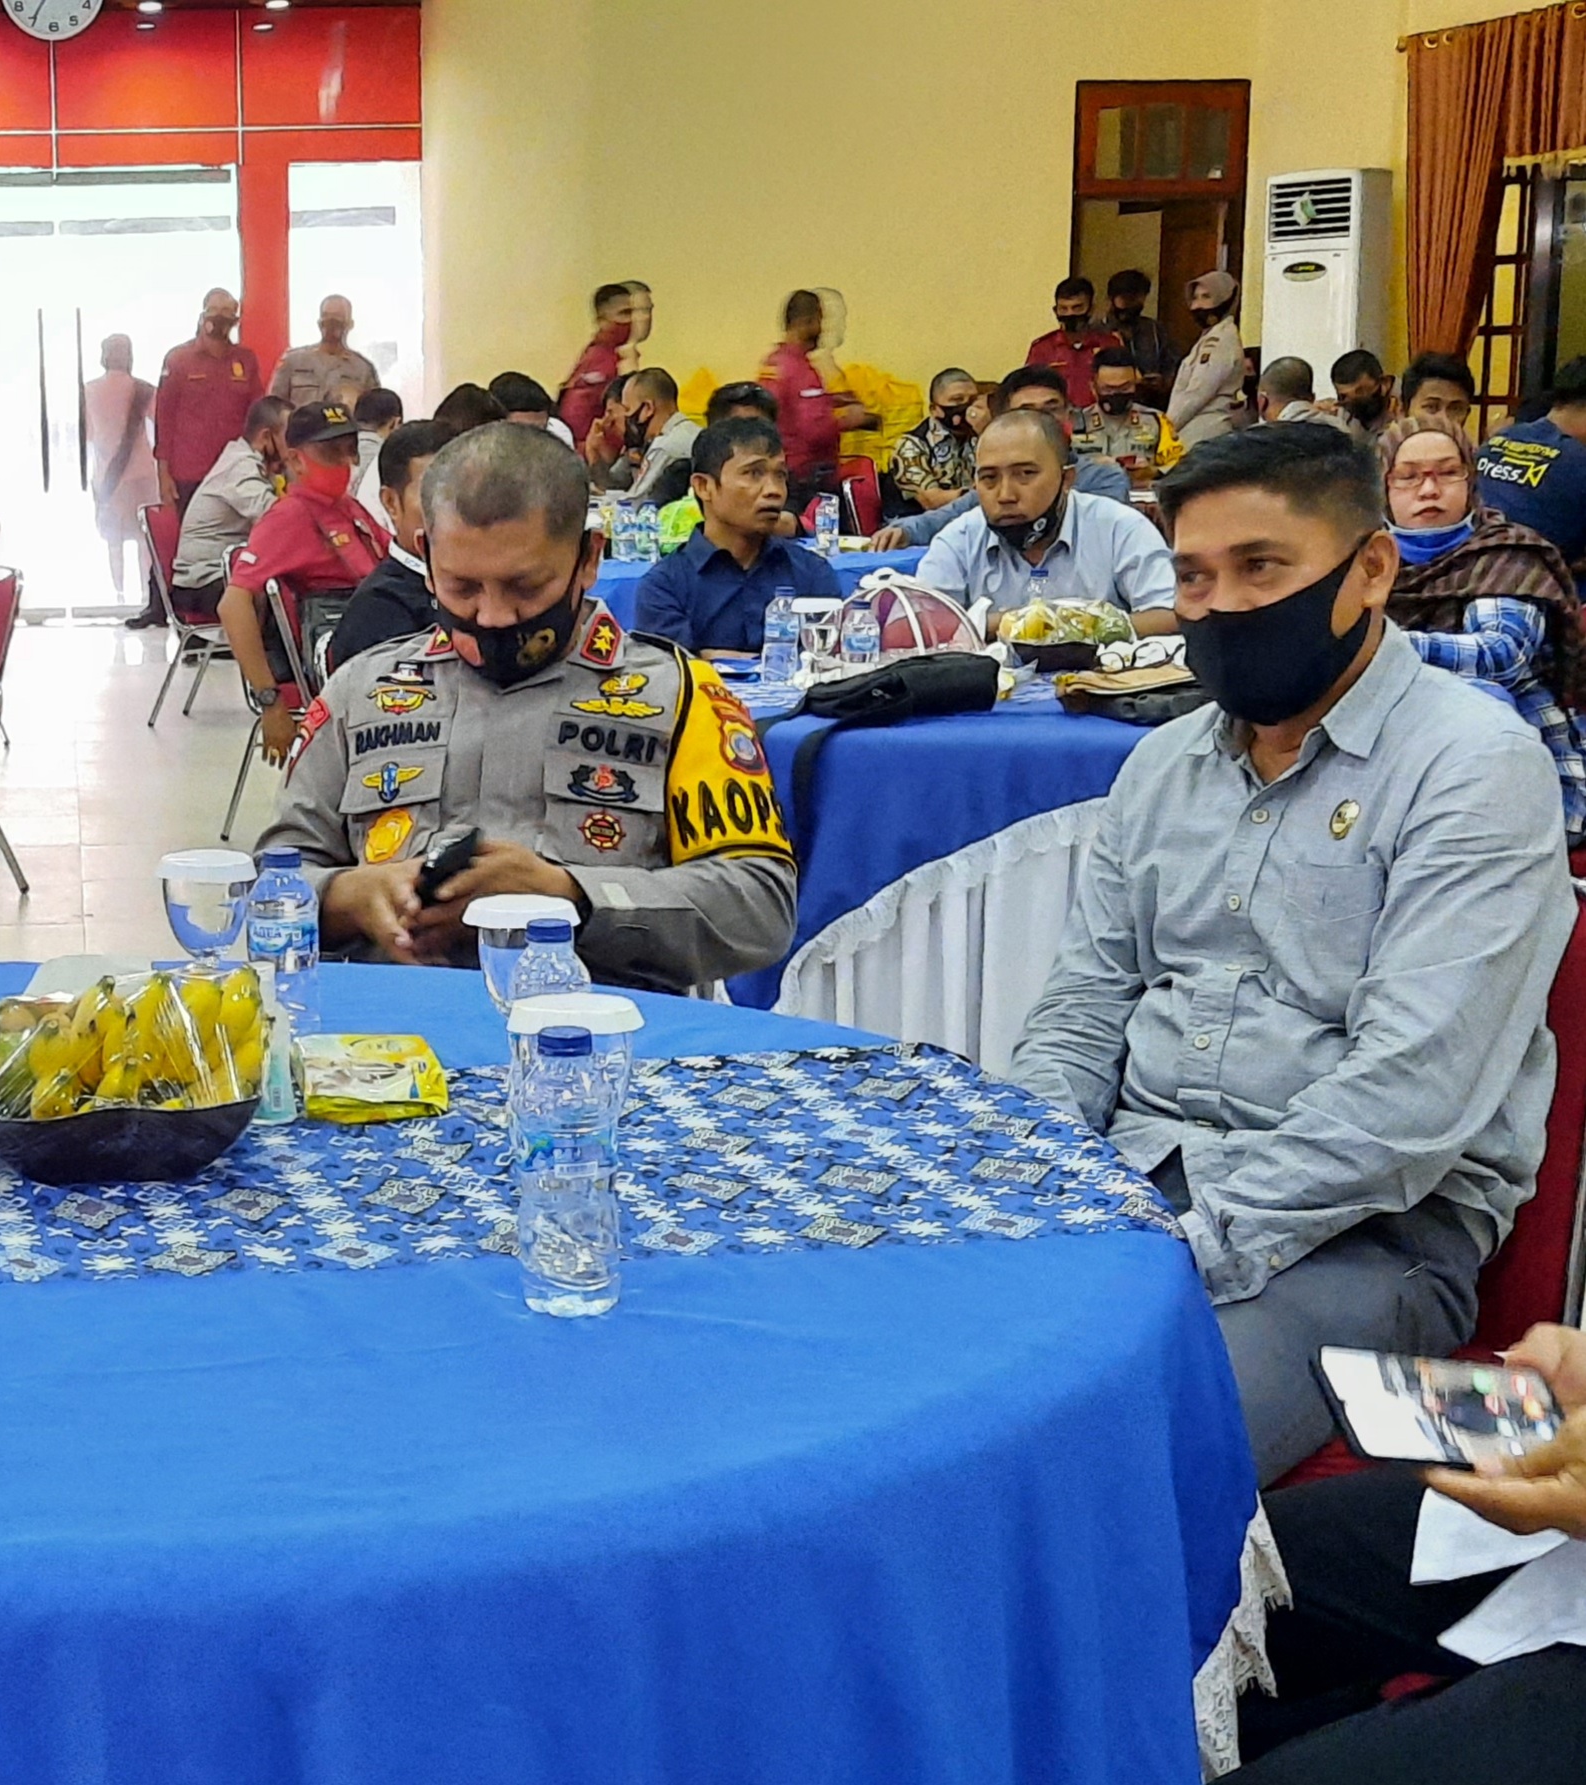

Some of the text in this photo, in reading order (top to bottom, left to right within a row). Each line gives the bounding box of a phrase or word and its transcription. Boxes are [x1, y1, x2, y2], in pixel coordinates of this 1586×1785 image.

[14, 1, 24, 12] 8
[82, 0, 91, 9] 4
[28, 16, 37, 27] 7
[69, 15, 78, 26] 5
[48, 22, 59, 32] 6
[355, 721, 441, 755] RAKHMAN
[558, 721, 659, 762] POLRI
[253, 925, 282, 940] AQUA
